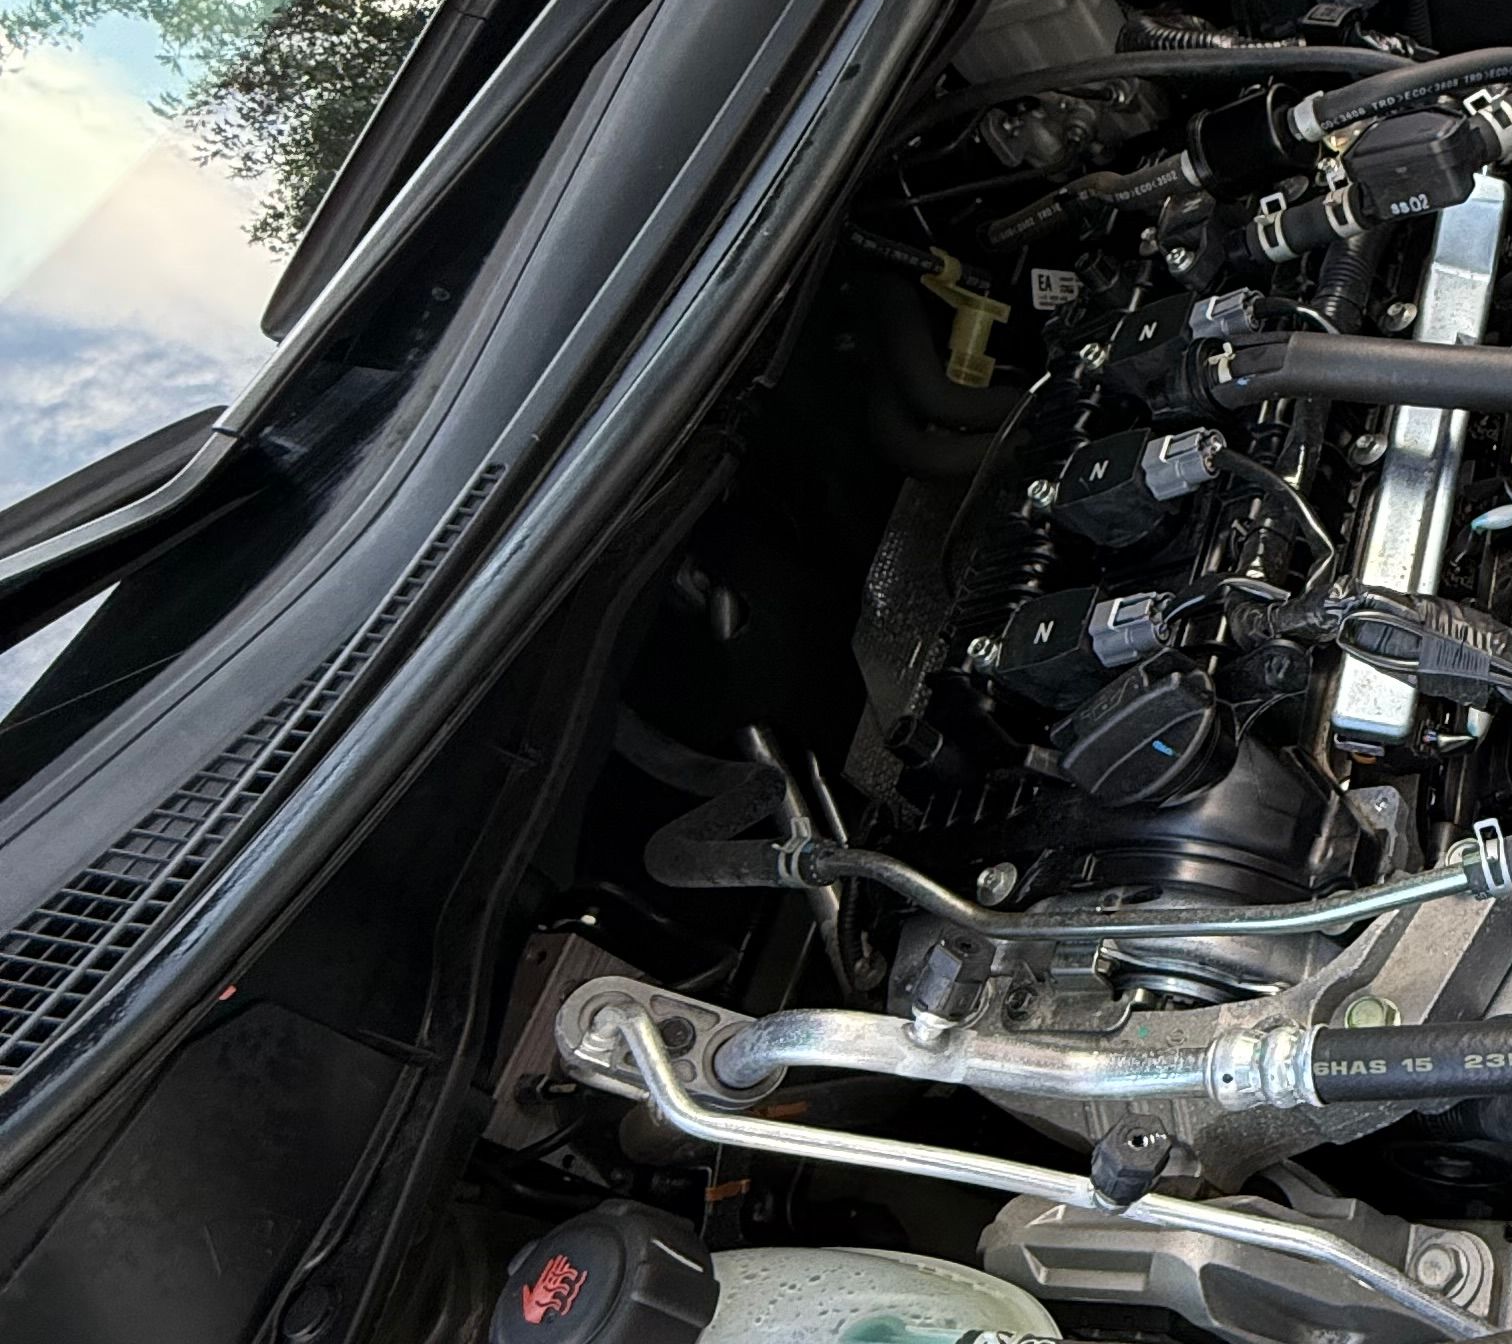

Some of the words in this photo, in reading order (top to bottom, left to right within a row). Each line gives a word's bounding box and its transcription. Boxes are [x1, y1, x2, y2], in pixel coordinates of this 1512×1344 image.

[1138, 322, 1157, 341] N
[1089, 460, 1110, 480] N
[1034, 621, 1055, 643] N
[1401, 1057, 1433, 1073] 15
